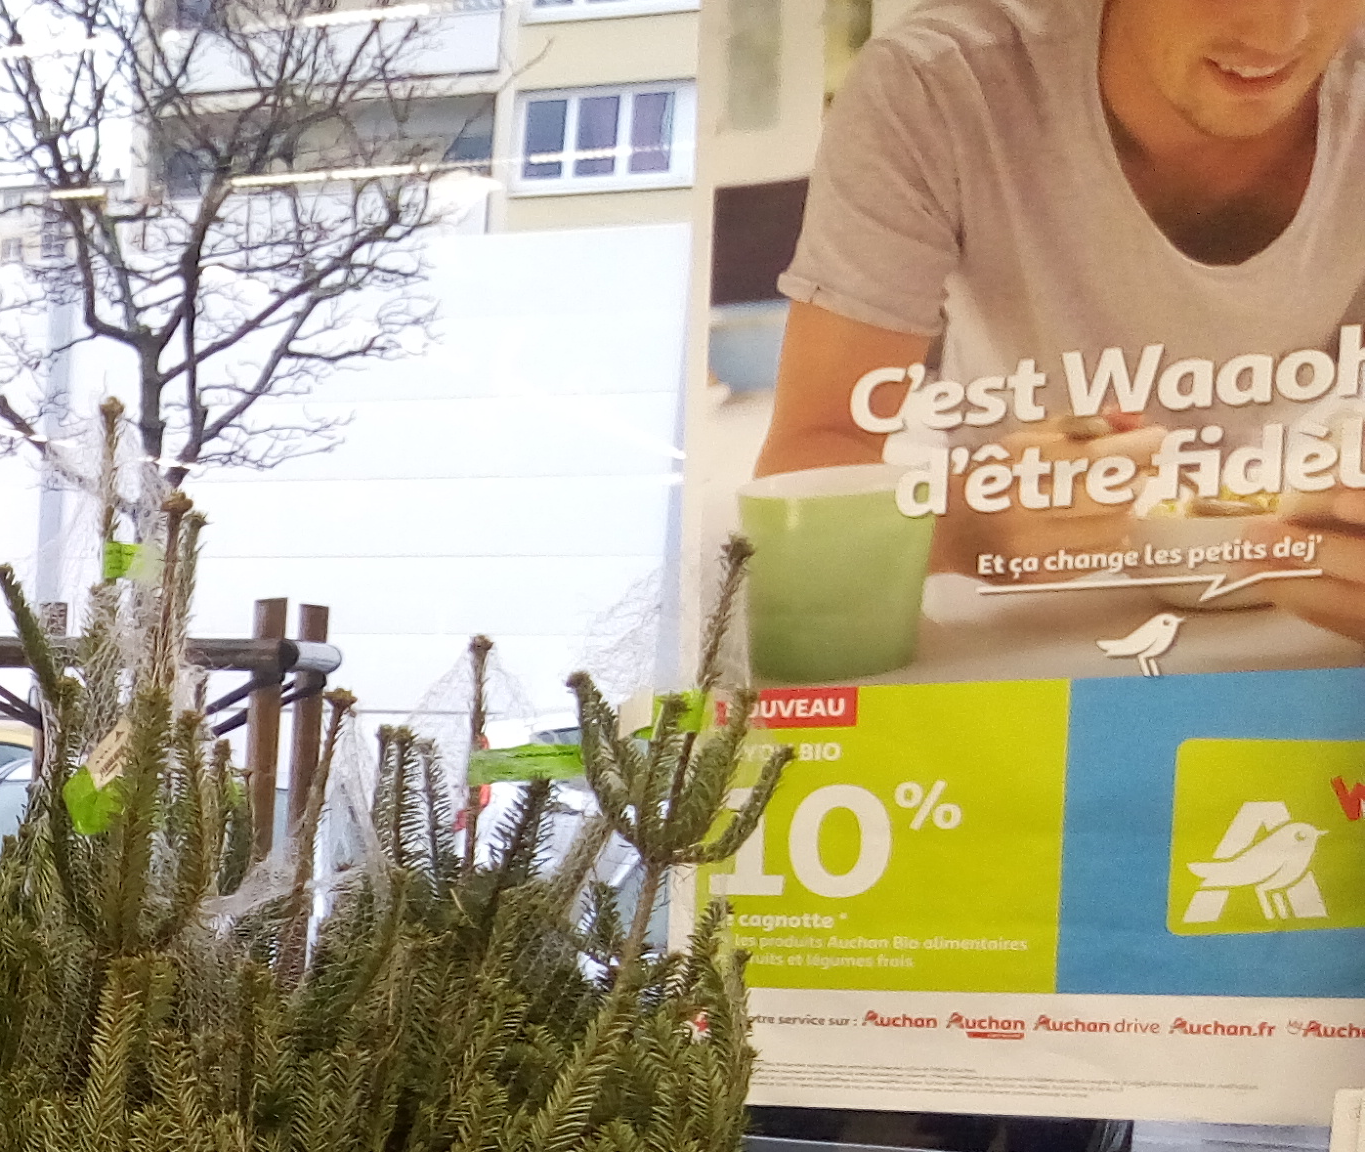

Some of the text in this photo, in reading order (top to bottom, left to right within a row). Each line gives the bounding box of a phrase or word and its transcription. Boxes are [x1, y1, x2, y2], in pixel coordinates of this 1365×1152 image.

[849, 358, 1046, 434] C'est
[894, 443, 1136, 518] d'être
[977, 553, 1006, 574] Et
[1009, 555, 1041, 579] ça
[1044, 549, 1139, 573] change
[1144, 545, 1182, 567] les
[1187, 539, 1268, 569] petits
[798, 742, 843, 761] BIO
[738, 913, 835, 932] cagnotte
[734, 934, 1029, 952] les produits Auchan Bio alimentaires
[743, 953, 915, 970] ruits et légumes frais
[778, 1013, 825, 1027] service
[828, 1017, 849, 1026] sur
[862, 1009, 938, 1029] Auchan
[945, 1011, 1025, 1031] Auchan
[1033, 1014, 1161, 1034] Auchan drive
[1169, 1016, 1276, 1037] Auchan.fr
